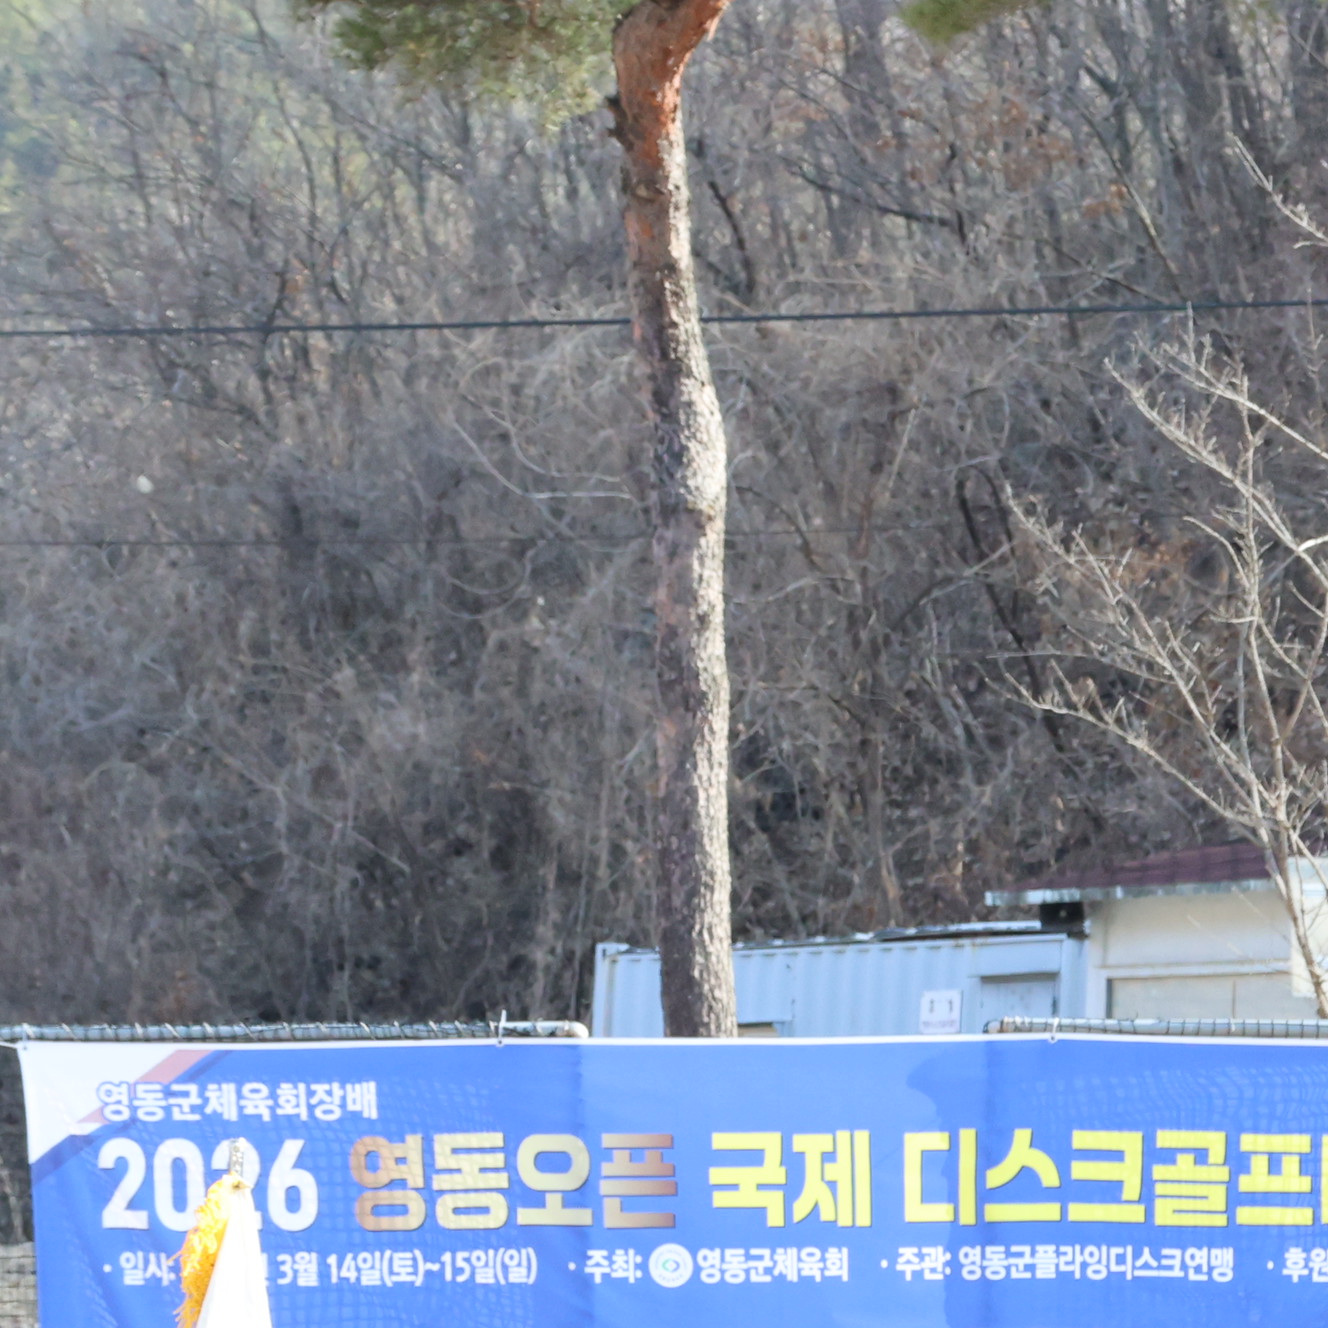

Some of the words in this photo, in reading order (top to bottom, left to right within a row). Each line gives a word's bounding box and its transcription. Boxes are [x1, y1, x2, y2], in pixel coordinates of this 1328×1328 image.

[98, 1081, 379, 1121] 영동군체육회장배
[348, 1132, 678, 1232] 영동오픈
[708, 1130, 871, 1228] 국제
[276, 1251, 319, 1287] 3월
[327, 1248, 538, 1287] 14일(토)~15일(일)
[584, 1250, 644, 1285] 주최:
[696, 1247, 850, 1285] 영동군체육회
[895, 1248, 953, 1282] 주관:
[958, 1246, 1236, 1283] 영동군플라잉디스크연맹
